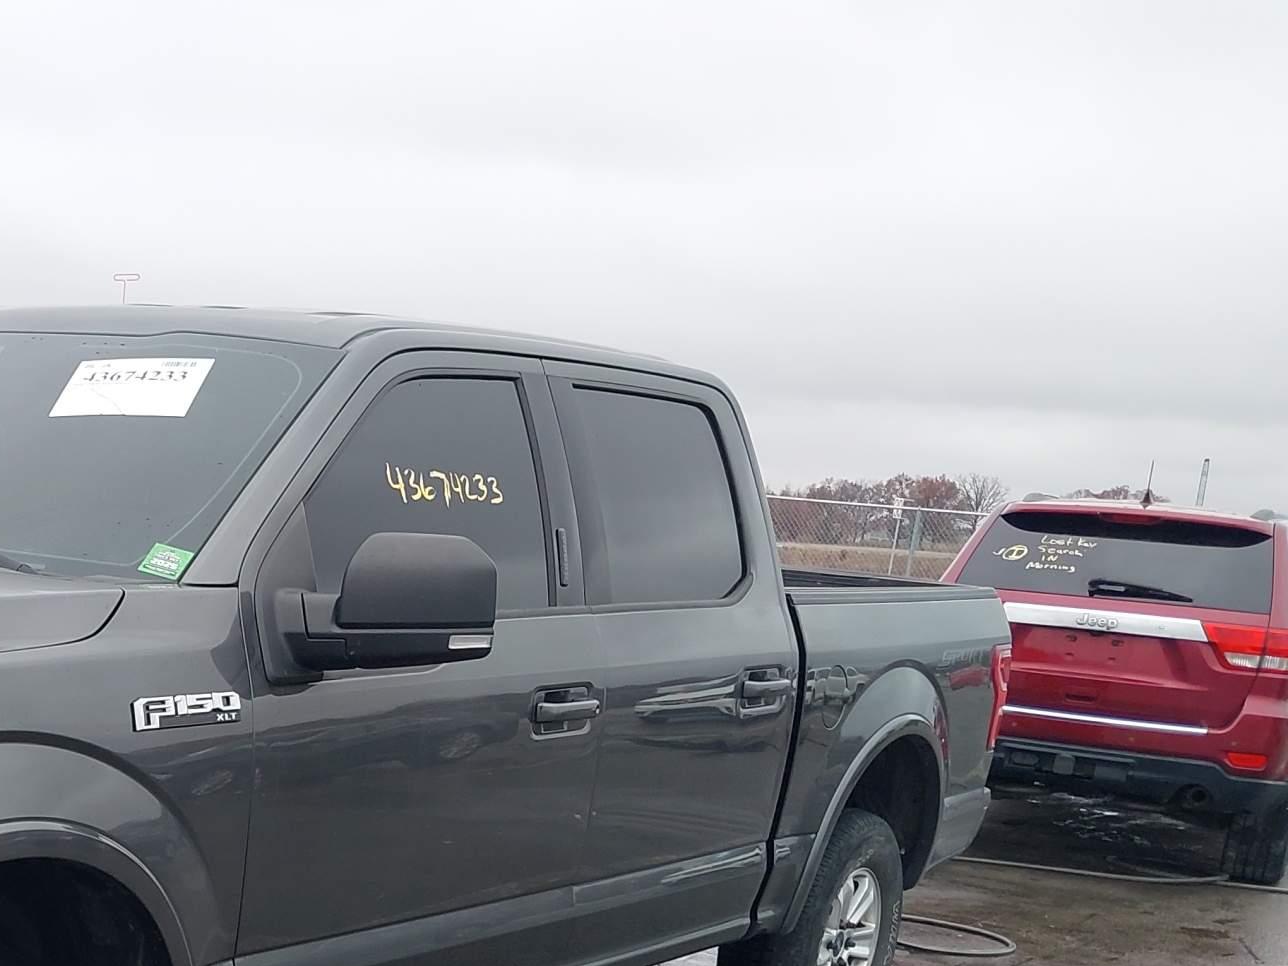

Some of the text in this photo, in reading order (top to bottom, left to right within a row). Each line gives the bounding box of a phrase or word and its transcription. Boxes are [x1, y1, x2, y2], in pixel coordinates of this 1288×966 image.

[83, 370, 188, 382] 43674233
[385, 462, 504, 508] 43674233
[1076, 613, 1118, 630] Jeep
[216, 712, 238, 721] XLT
